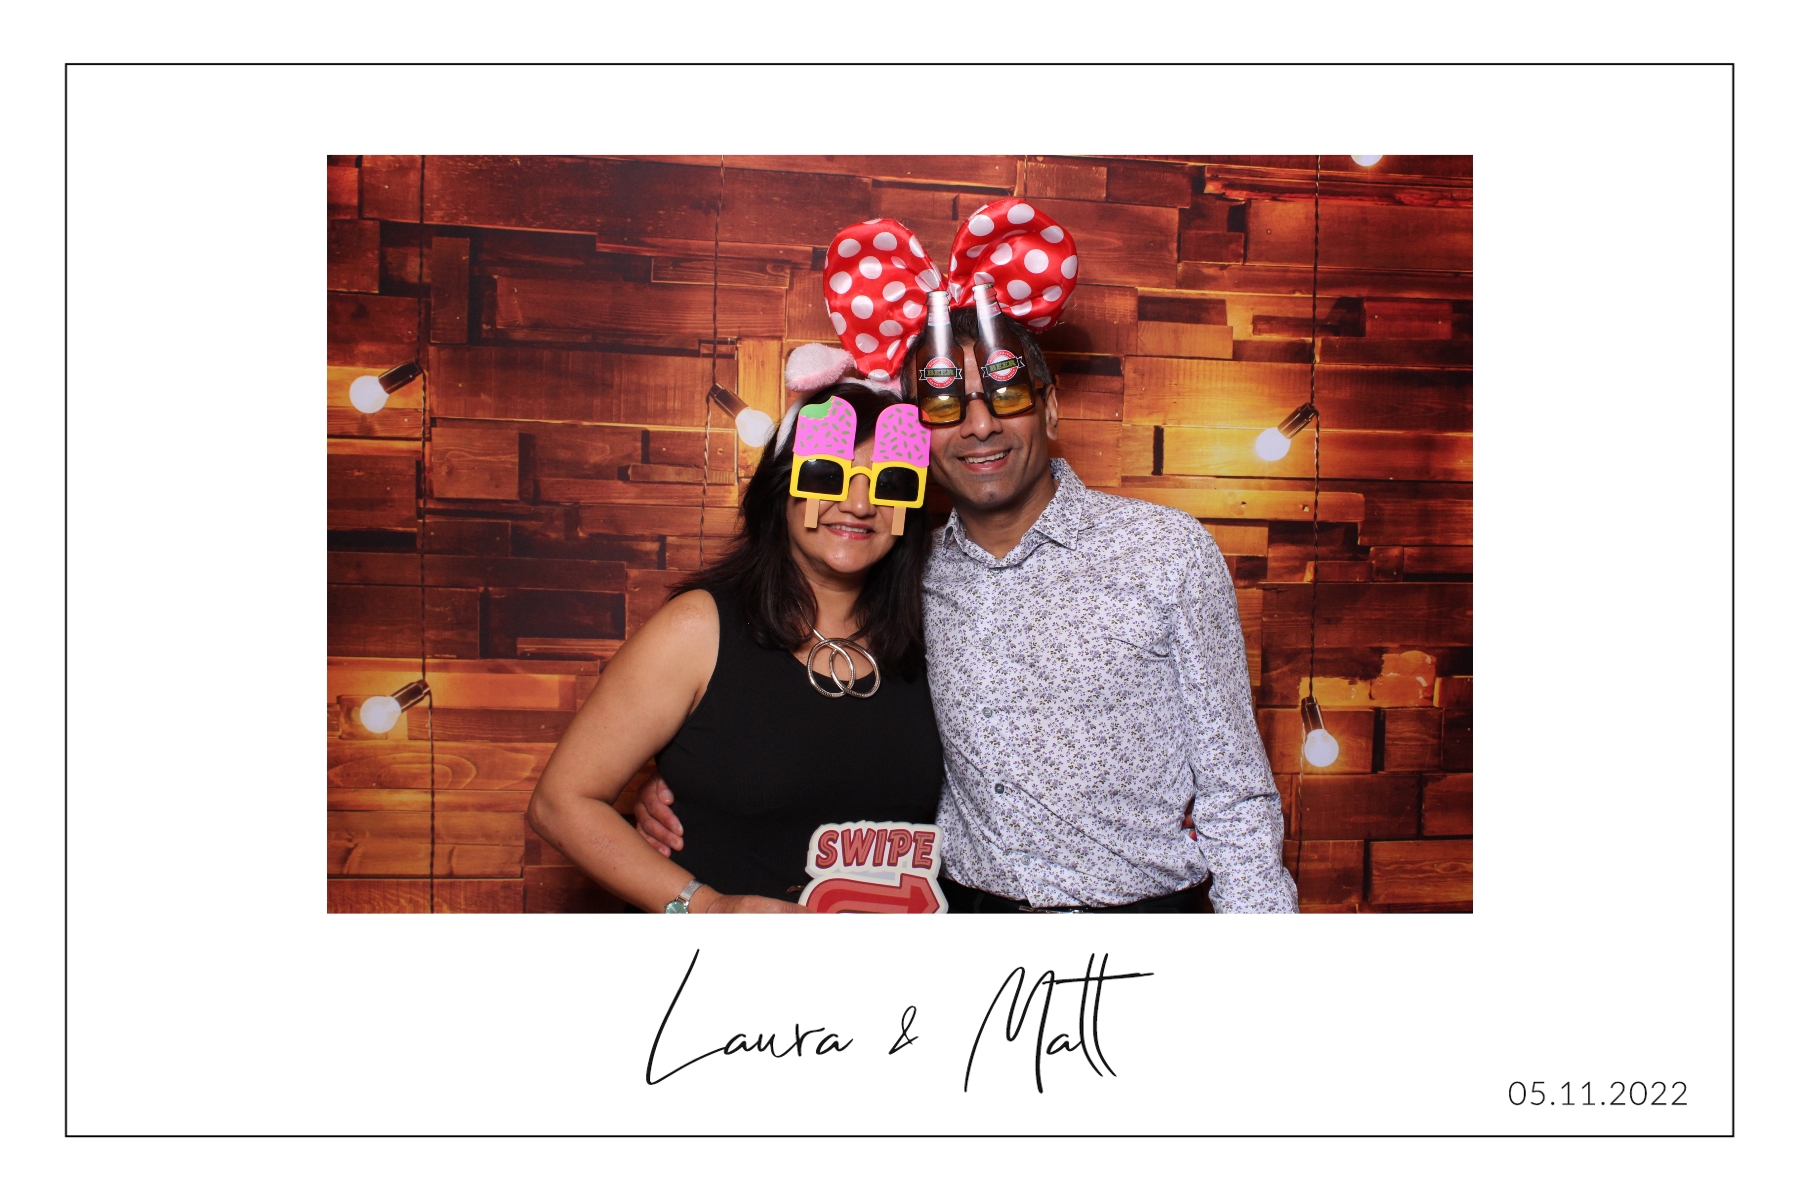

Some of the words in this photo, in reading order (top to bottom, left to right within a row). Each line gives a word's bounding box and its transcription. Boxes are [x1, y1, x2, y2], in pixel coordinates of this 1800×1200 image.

[927, 369, 955, 377] BEER
[989, 359, 1017, 373] BEER
[815, 828, 936, 870] SWIPE
